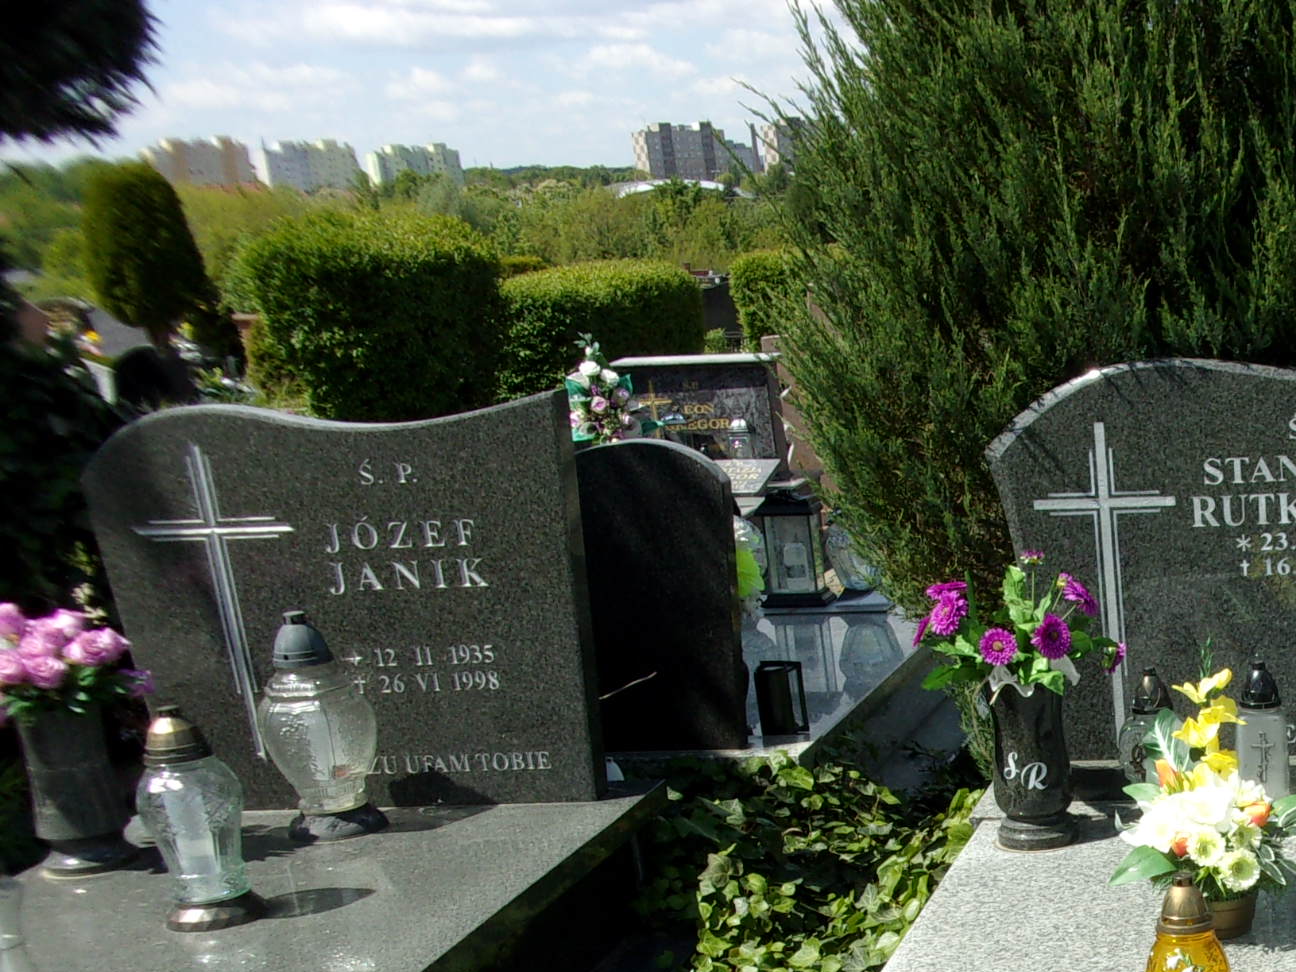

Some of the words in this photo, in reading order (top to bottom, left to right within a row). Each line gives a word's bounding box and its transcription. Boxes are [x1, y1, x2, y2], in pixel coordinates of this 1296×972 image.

[394, 462, 418, 484] P.
[325, 516, 476, 553] JÓZEF
[1260, 532, 1296, 551] 23.
[329, 558, 489, 595] JANIK
[373, 648, 399, 667] 12
[450, 644, 495, 665] 1935
[379, 674, 405, 693] 26
[416, 672, 441, 692] VI
[452, 670, 500, 691] 1998
[367, 755, 398, 775] ZU
[404, 753, 471, 774] UFAM
[473, 751, 552, 772] TOBIE
